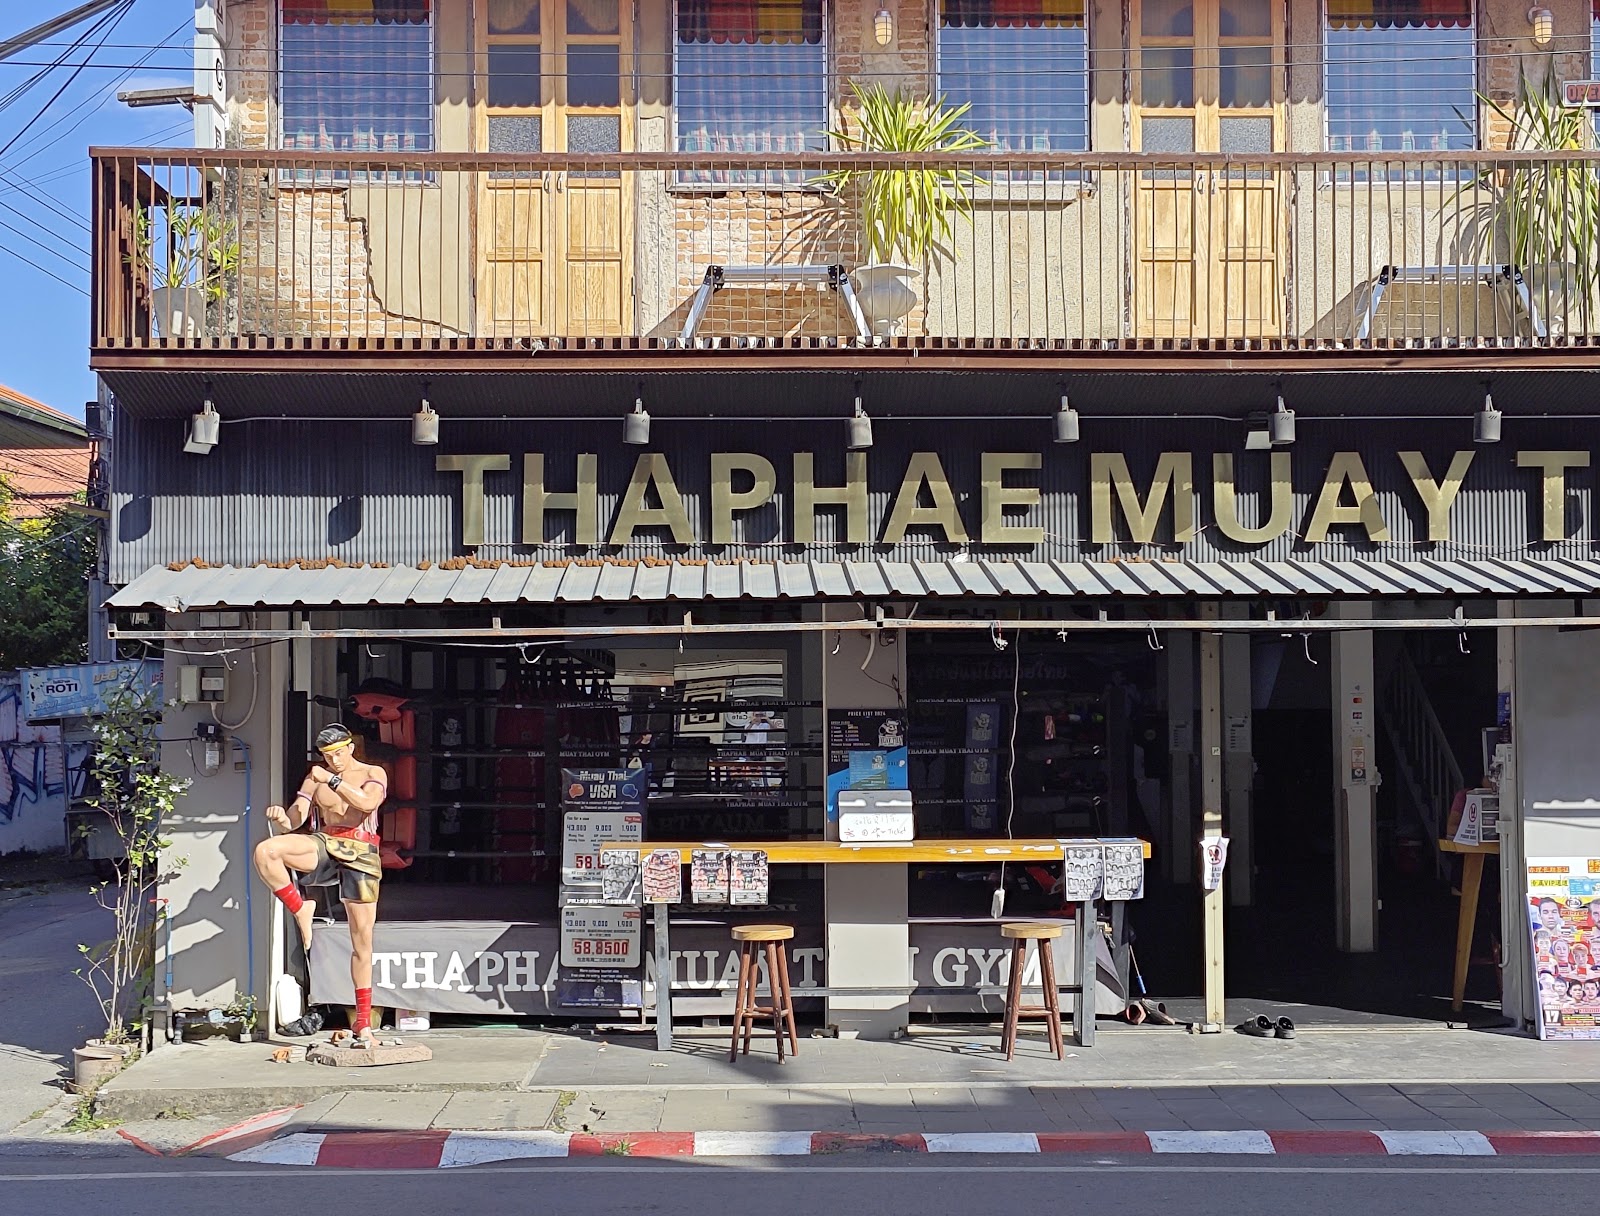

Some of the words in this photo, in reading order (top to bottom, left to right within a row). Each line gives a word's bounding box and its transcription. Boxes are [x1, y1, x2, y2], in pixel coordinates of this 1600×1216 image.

[436, 452, 1044, 545] THAPHAE
[1091, 450, 1475, 543] MUAY
[46, 683, 78, 695] ROTI
[579, 771, 604, 784] Muay
[607, 771, 628, 781] Thai
[590, 784, 617, 799] VISA
[574, 941, 628, 955] 58.8500
[1545, 1010, 1560, 1023] 17
